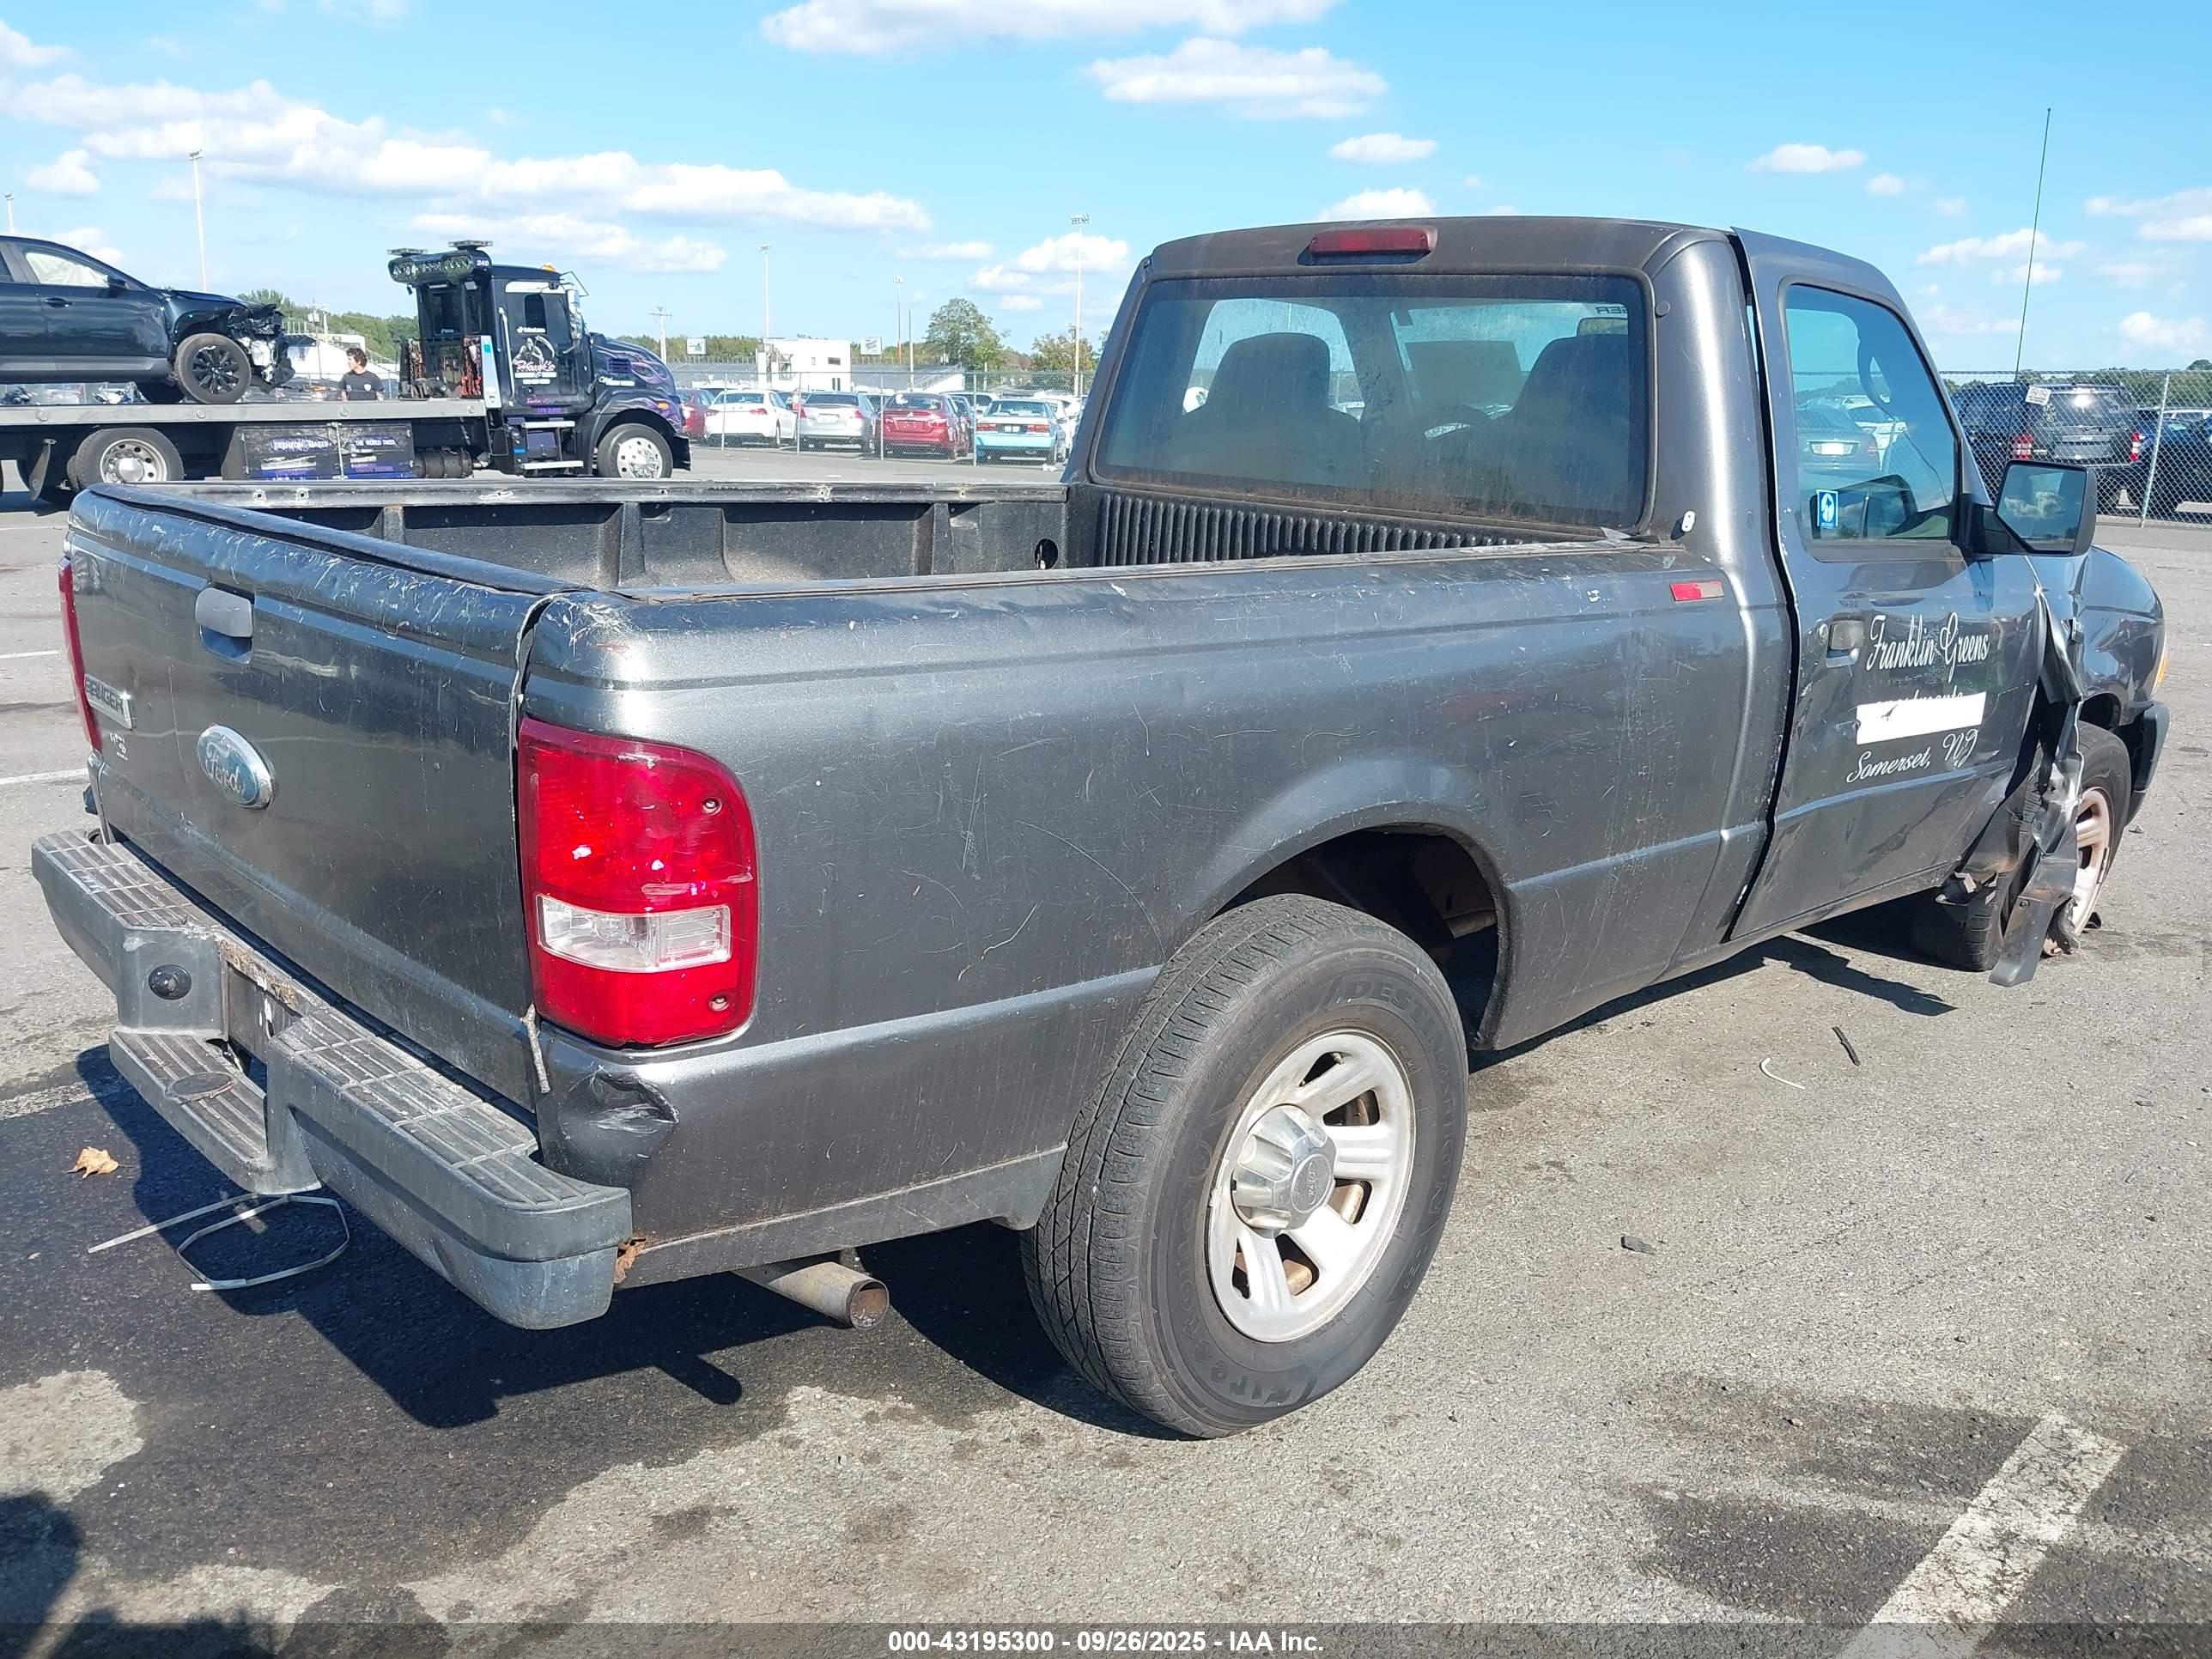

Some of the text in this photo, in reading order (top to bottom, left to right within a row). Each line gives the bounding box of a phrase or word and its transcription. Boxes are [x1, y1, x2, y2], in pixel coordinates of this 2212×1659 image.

[1866, 611, 1991, 683] Franklin Greens
[1846, 728, 1978, 783] Somerset, NJ
